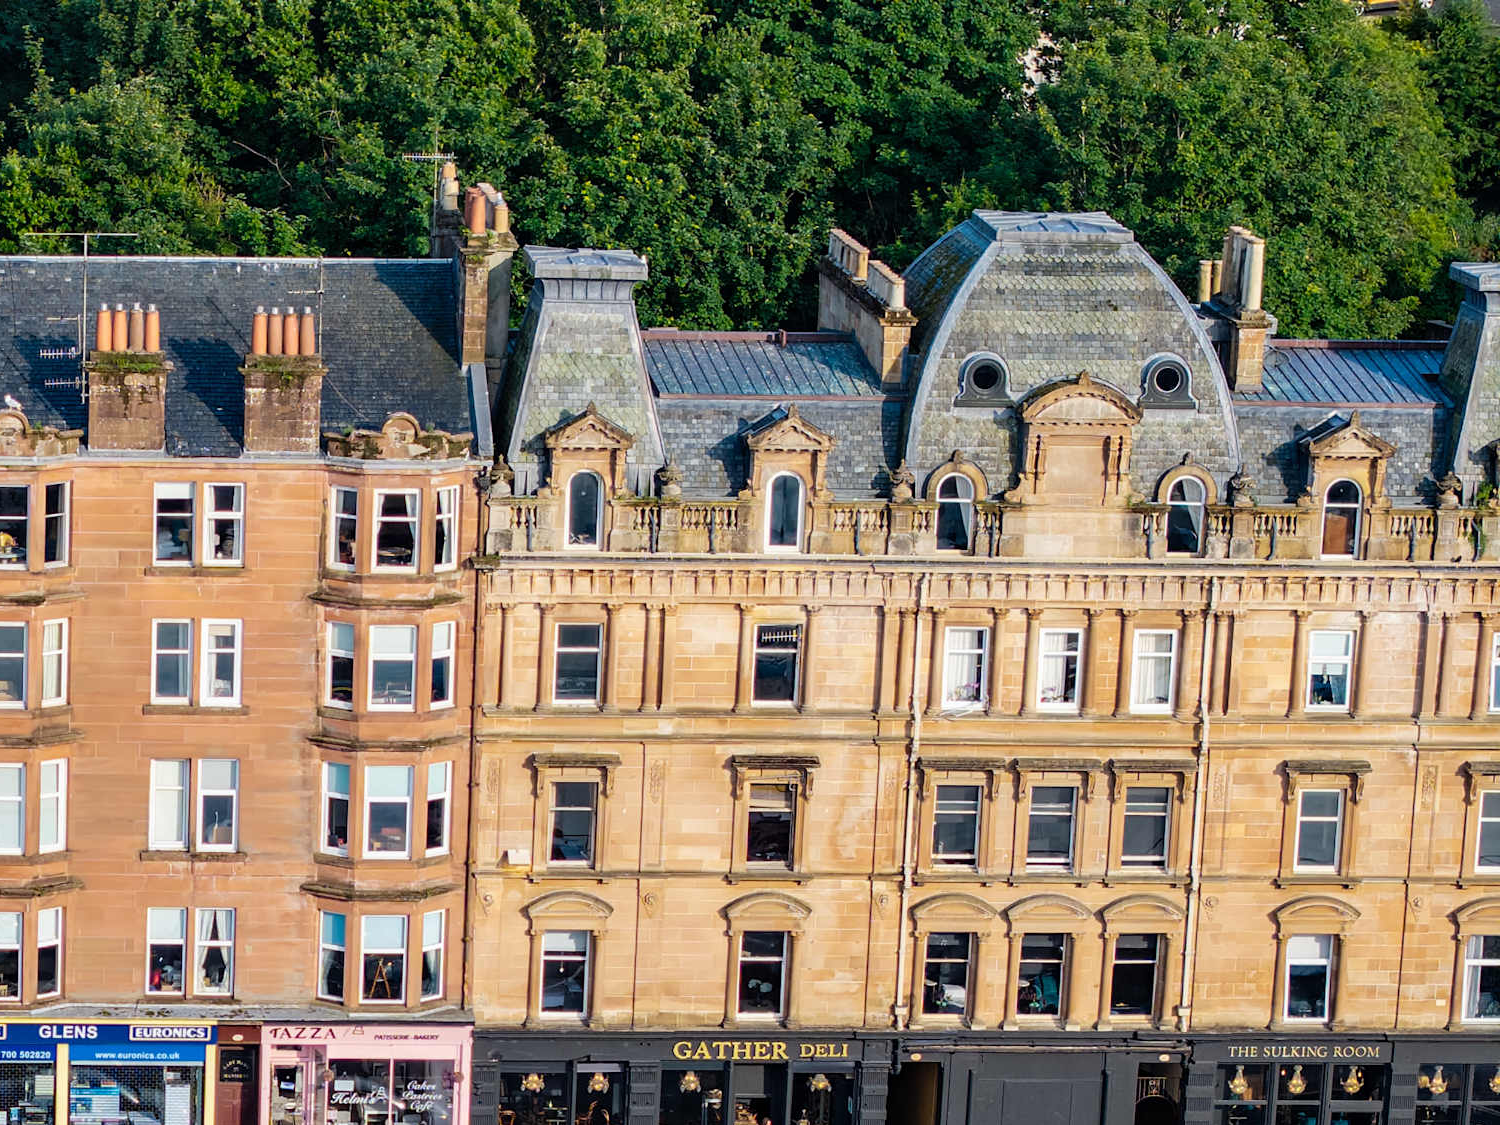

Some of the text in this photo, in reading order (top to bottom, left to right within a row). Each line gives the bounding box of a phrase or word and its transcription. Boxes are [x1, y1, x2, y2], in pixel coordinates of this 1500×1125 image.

[39, 1025, 98, 1039] GLENS
[135, 1027, 206, 1038] EURONICS
[269, 1027, 336, 1040] TAZZA
[95, 1051, 181, 1060] www.euronics.co.uk
[672, 1041, 849, 1060] GATHER DELI
[1228, 1046, 1380, 1058] THE SULKING ROOM
